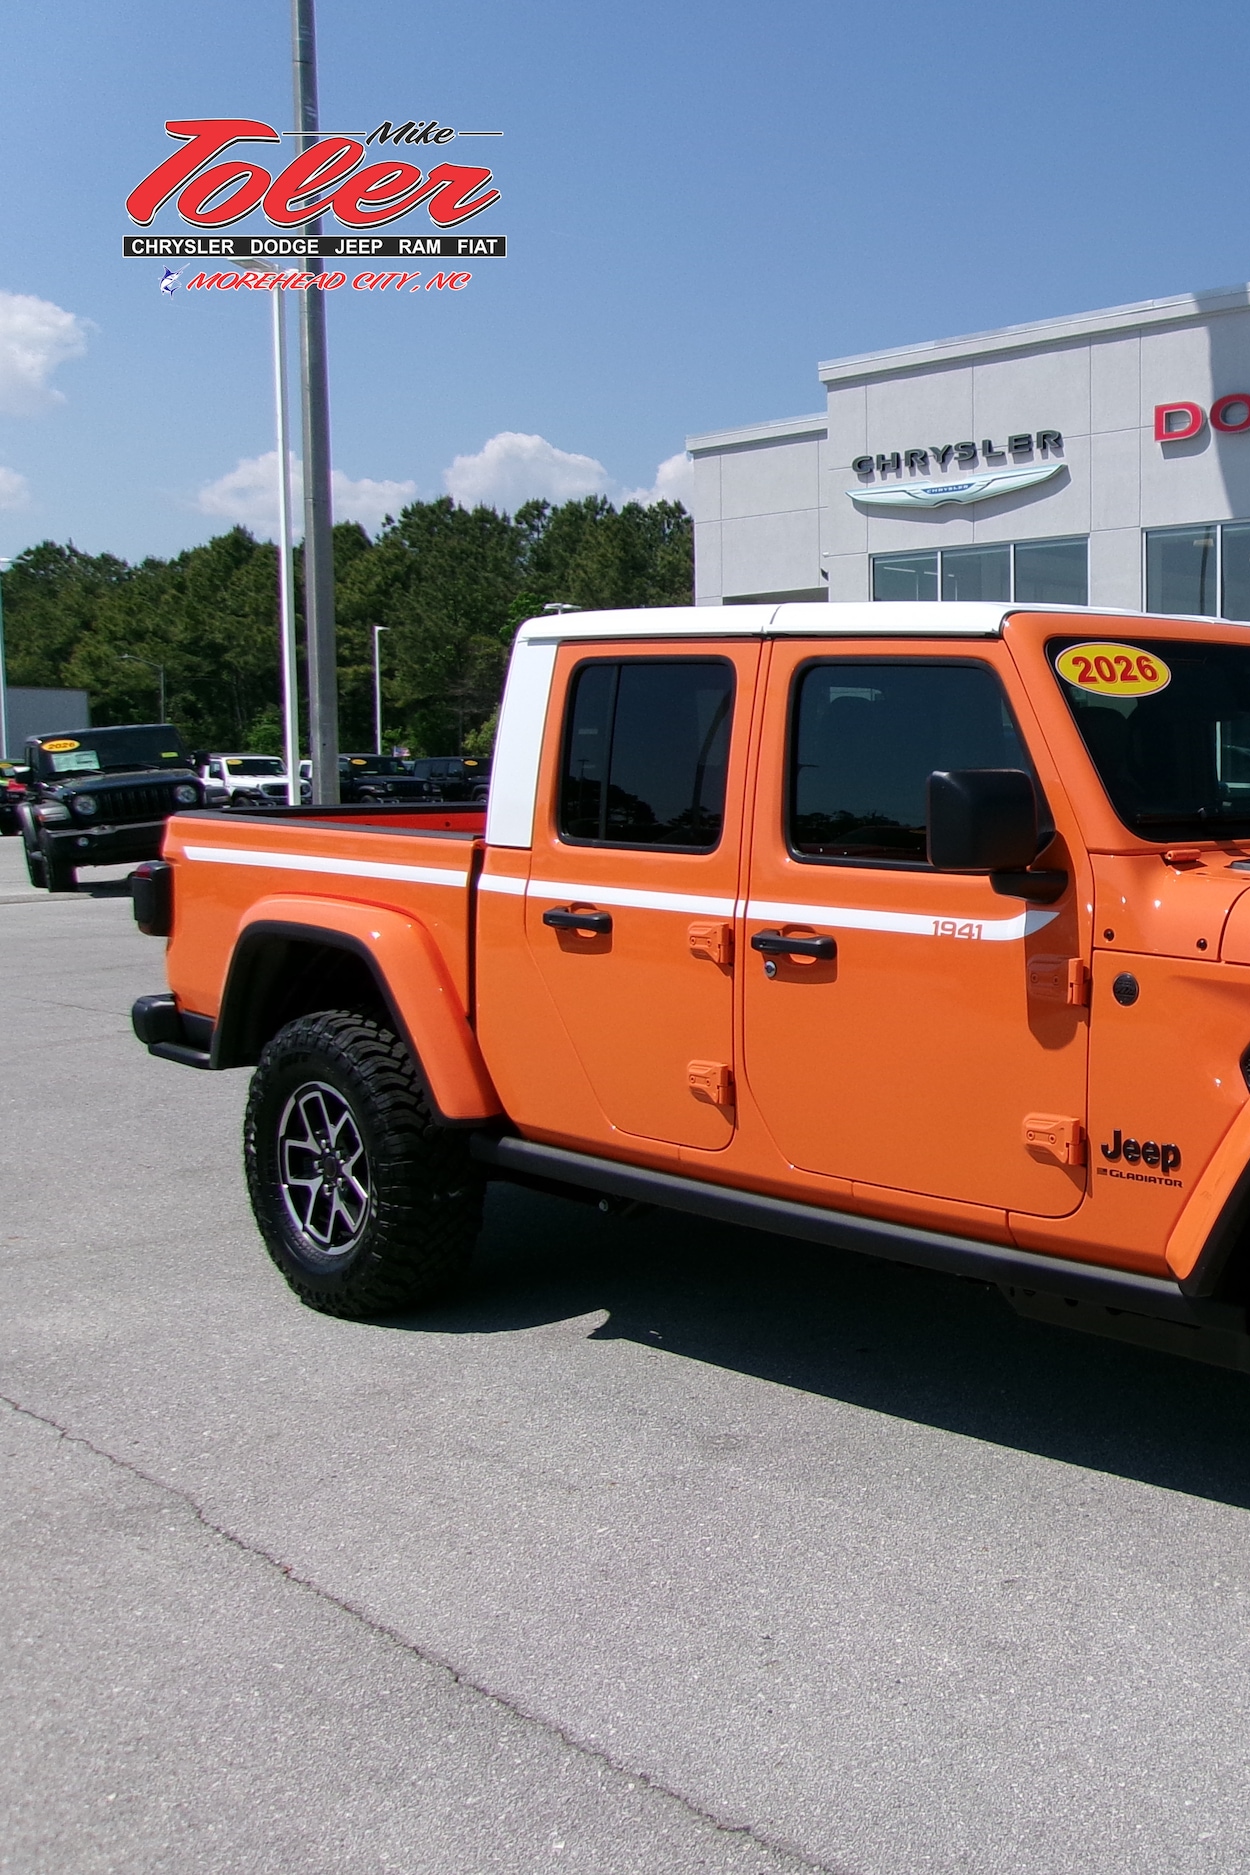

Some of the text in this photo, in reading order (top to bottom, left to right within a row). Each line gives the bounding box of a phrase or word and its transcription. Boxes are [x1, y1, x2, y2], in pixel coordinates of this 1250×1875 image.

[852, 430, 1064, 474] CHRYSLER
[926, 484, 969, 494] CHRYSLER
[1071, 655, 1160, 683] 2026
[48, 742, 75, 750] 2026
[932, 920, 983, 940] 1941
[1101, 1129, 1181, 1174] Jeep
[1109, 1169, 1183, 1188] GLADIATOR
